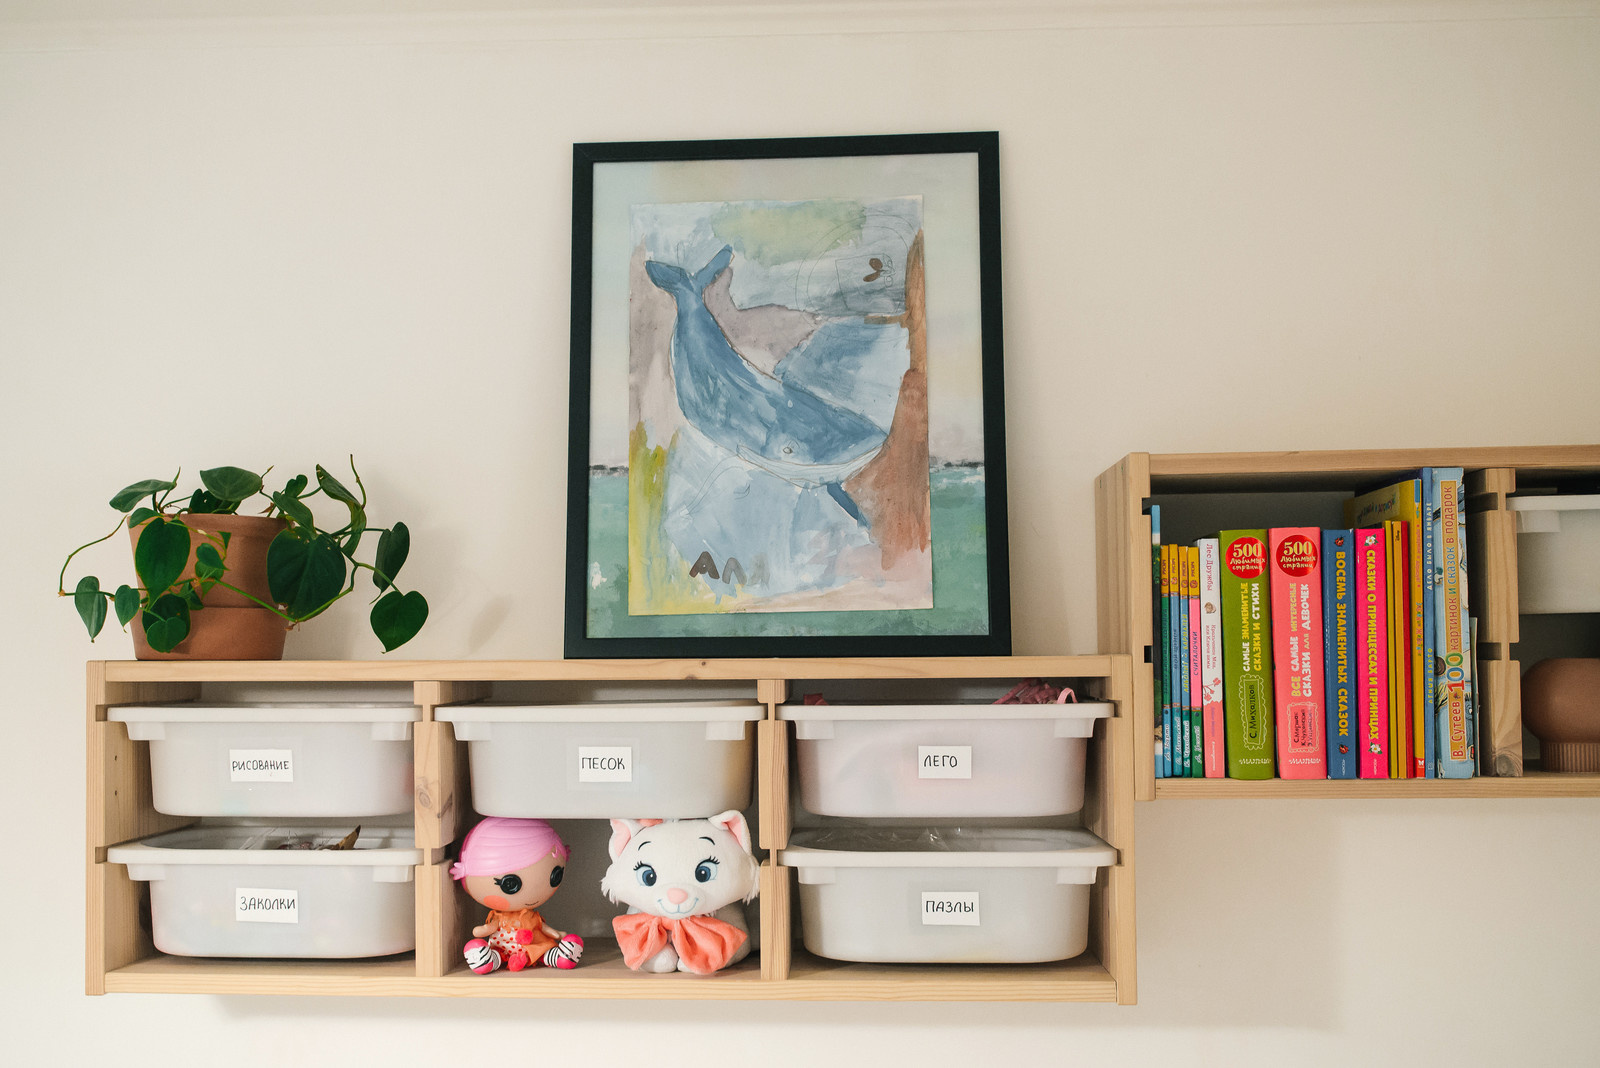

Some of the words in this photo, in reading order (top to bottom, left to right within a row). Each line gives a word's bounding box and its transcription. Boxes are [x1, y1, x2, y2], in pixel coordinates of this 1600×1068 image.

[1444, 486, 1455, 534] подарок
[1233, 543, 1262, 557] 500
[1282, 562, 1314, 571] страниц
[1283, 541, 1313, 556] 500
[1447, 546, 1456, 584] сказок
[1336, 551, 1346, 600] ВОСЕМЬ
[1366, 549, 1376, 591] СКАЗКИ
[1240, 582, 1250, 640] ЗНАМЕНИТЫЕ
[1251, 583, 1260, 620] СТИХИ
[1289, 583, 1298, 632] ИНТЕРЕСНЫЕ
[1300, 583, 1311, 630] ДЕВОЧЕК
[1367, 593, 1376, 602] О
[1253, 622, 1261, 631] И
[1367, 605, 1378, 674] ПРИНЦЕССАХ
[1448, 597, 1461, 650] картинок
[1242, 642, 1251, 672] САМЫЕ
[1253, 633, 1262, 672] СКАЗКИ
[1289, 636, 1300, 672] САМЫЕ
[1336, 603, 1348, 683] ЗНАМЕНИТЫХ
[1291, 676, 1301, 697] ВСЕ
[1301, 652, 1312, 698] СКАЗКИ
[1368, 677, 1378, 685] И
[1445, 652, 1465, 692] 100
[1337, 688, 1349, 736] СКАЗОК
[1368, 688, 1379, 740] ПРИНЦАХ
[1451, 701, 1465, 742] Сутеев
[232, 760, 289, 771] РИСОВАНИЕ
[581, 757, 625, 770] ПЕСОК
[923, 754, 958, 768] ЛЕГО
[1452, 746, 1464, 757] В.
[240, 896, 295, 911] ЗАКОЛКИ
[925, 900, 974, 913] ПАЗЛЫ
